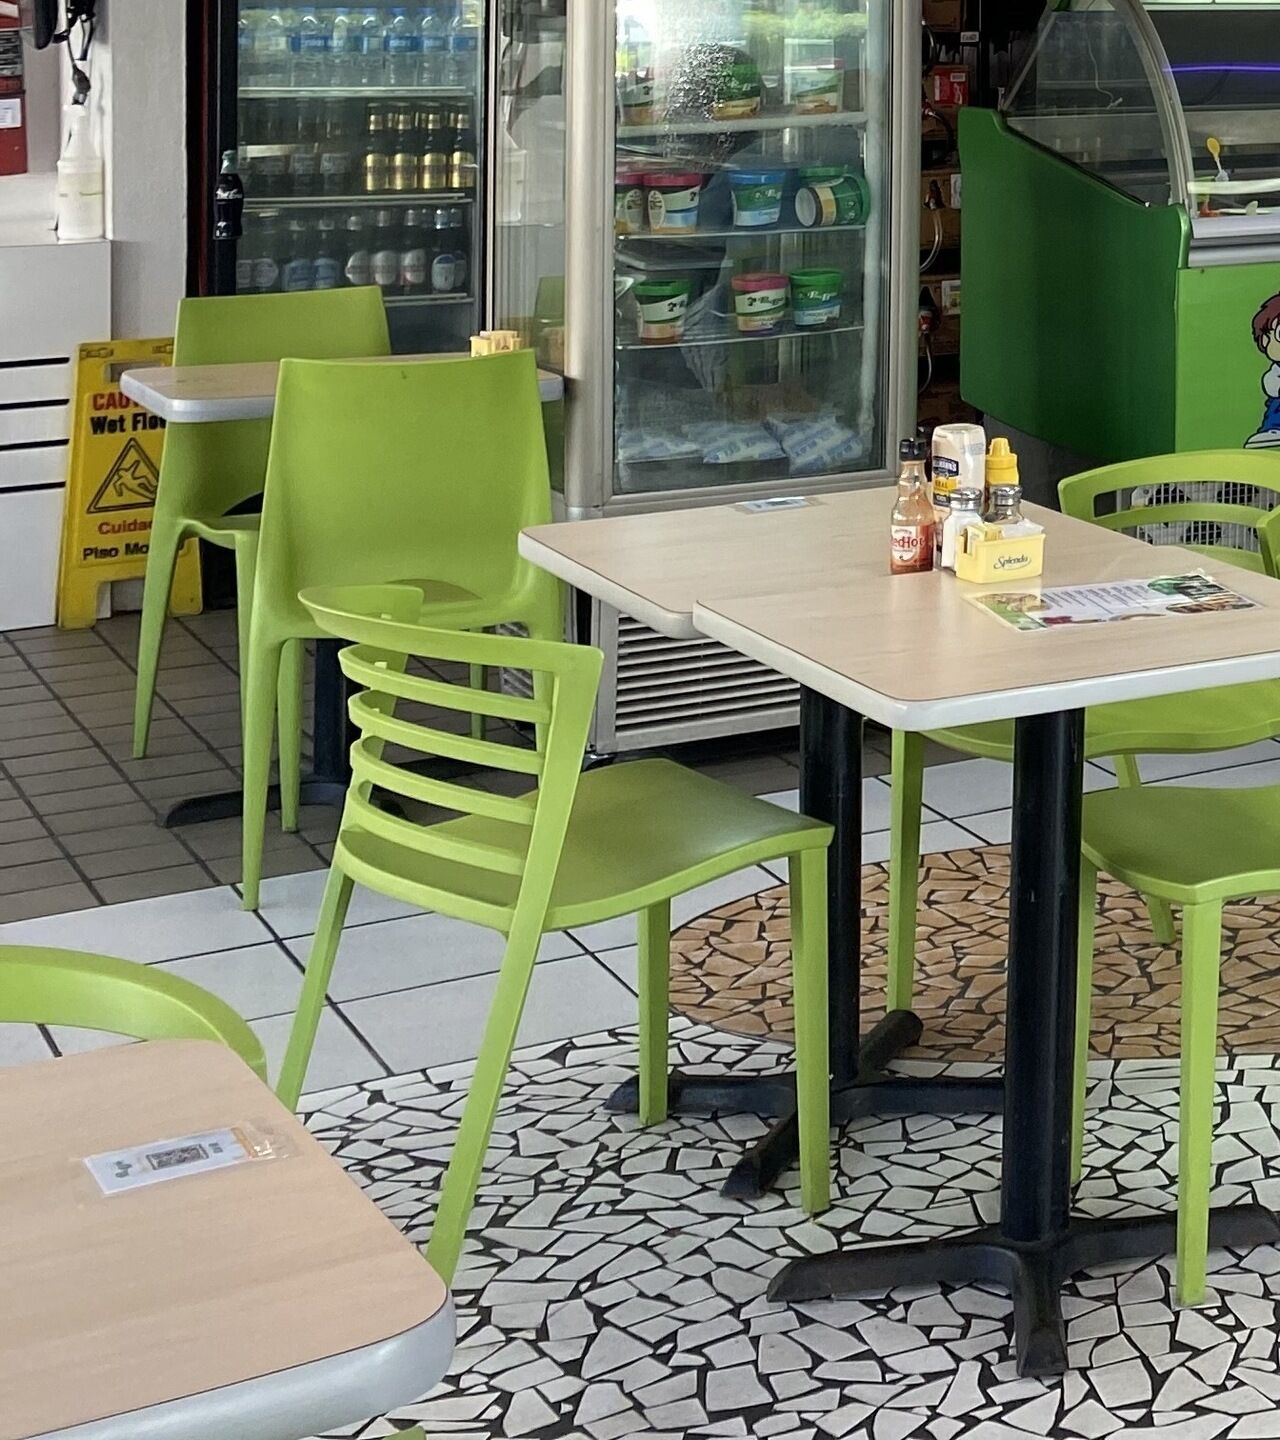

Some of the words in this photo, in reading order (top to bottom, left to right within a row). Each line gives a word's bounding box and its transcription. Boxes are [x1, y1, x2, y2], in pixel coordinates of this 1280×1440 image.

[93, 392, 139, 411] CAU
[90, 415, 126, 435] Wet
[132, 412, 167, 432] Floo
[83, 546, 118, 561] Piso
[993, 554, 1033, 571] Splenda
